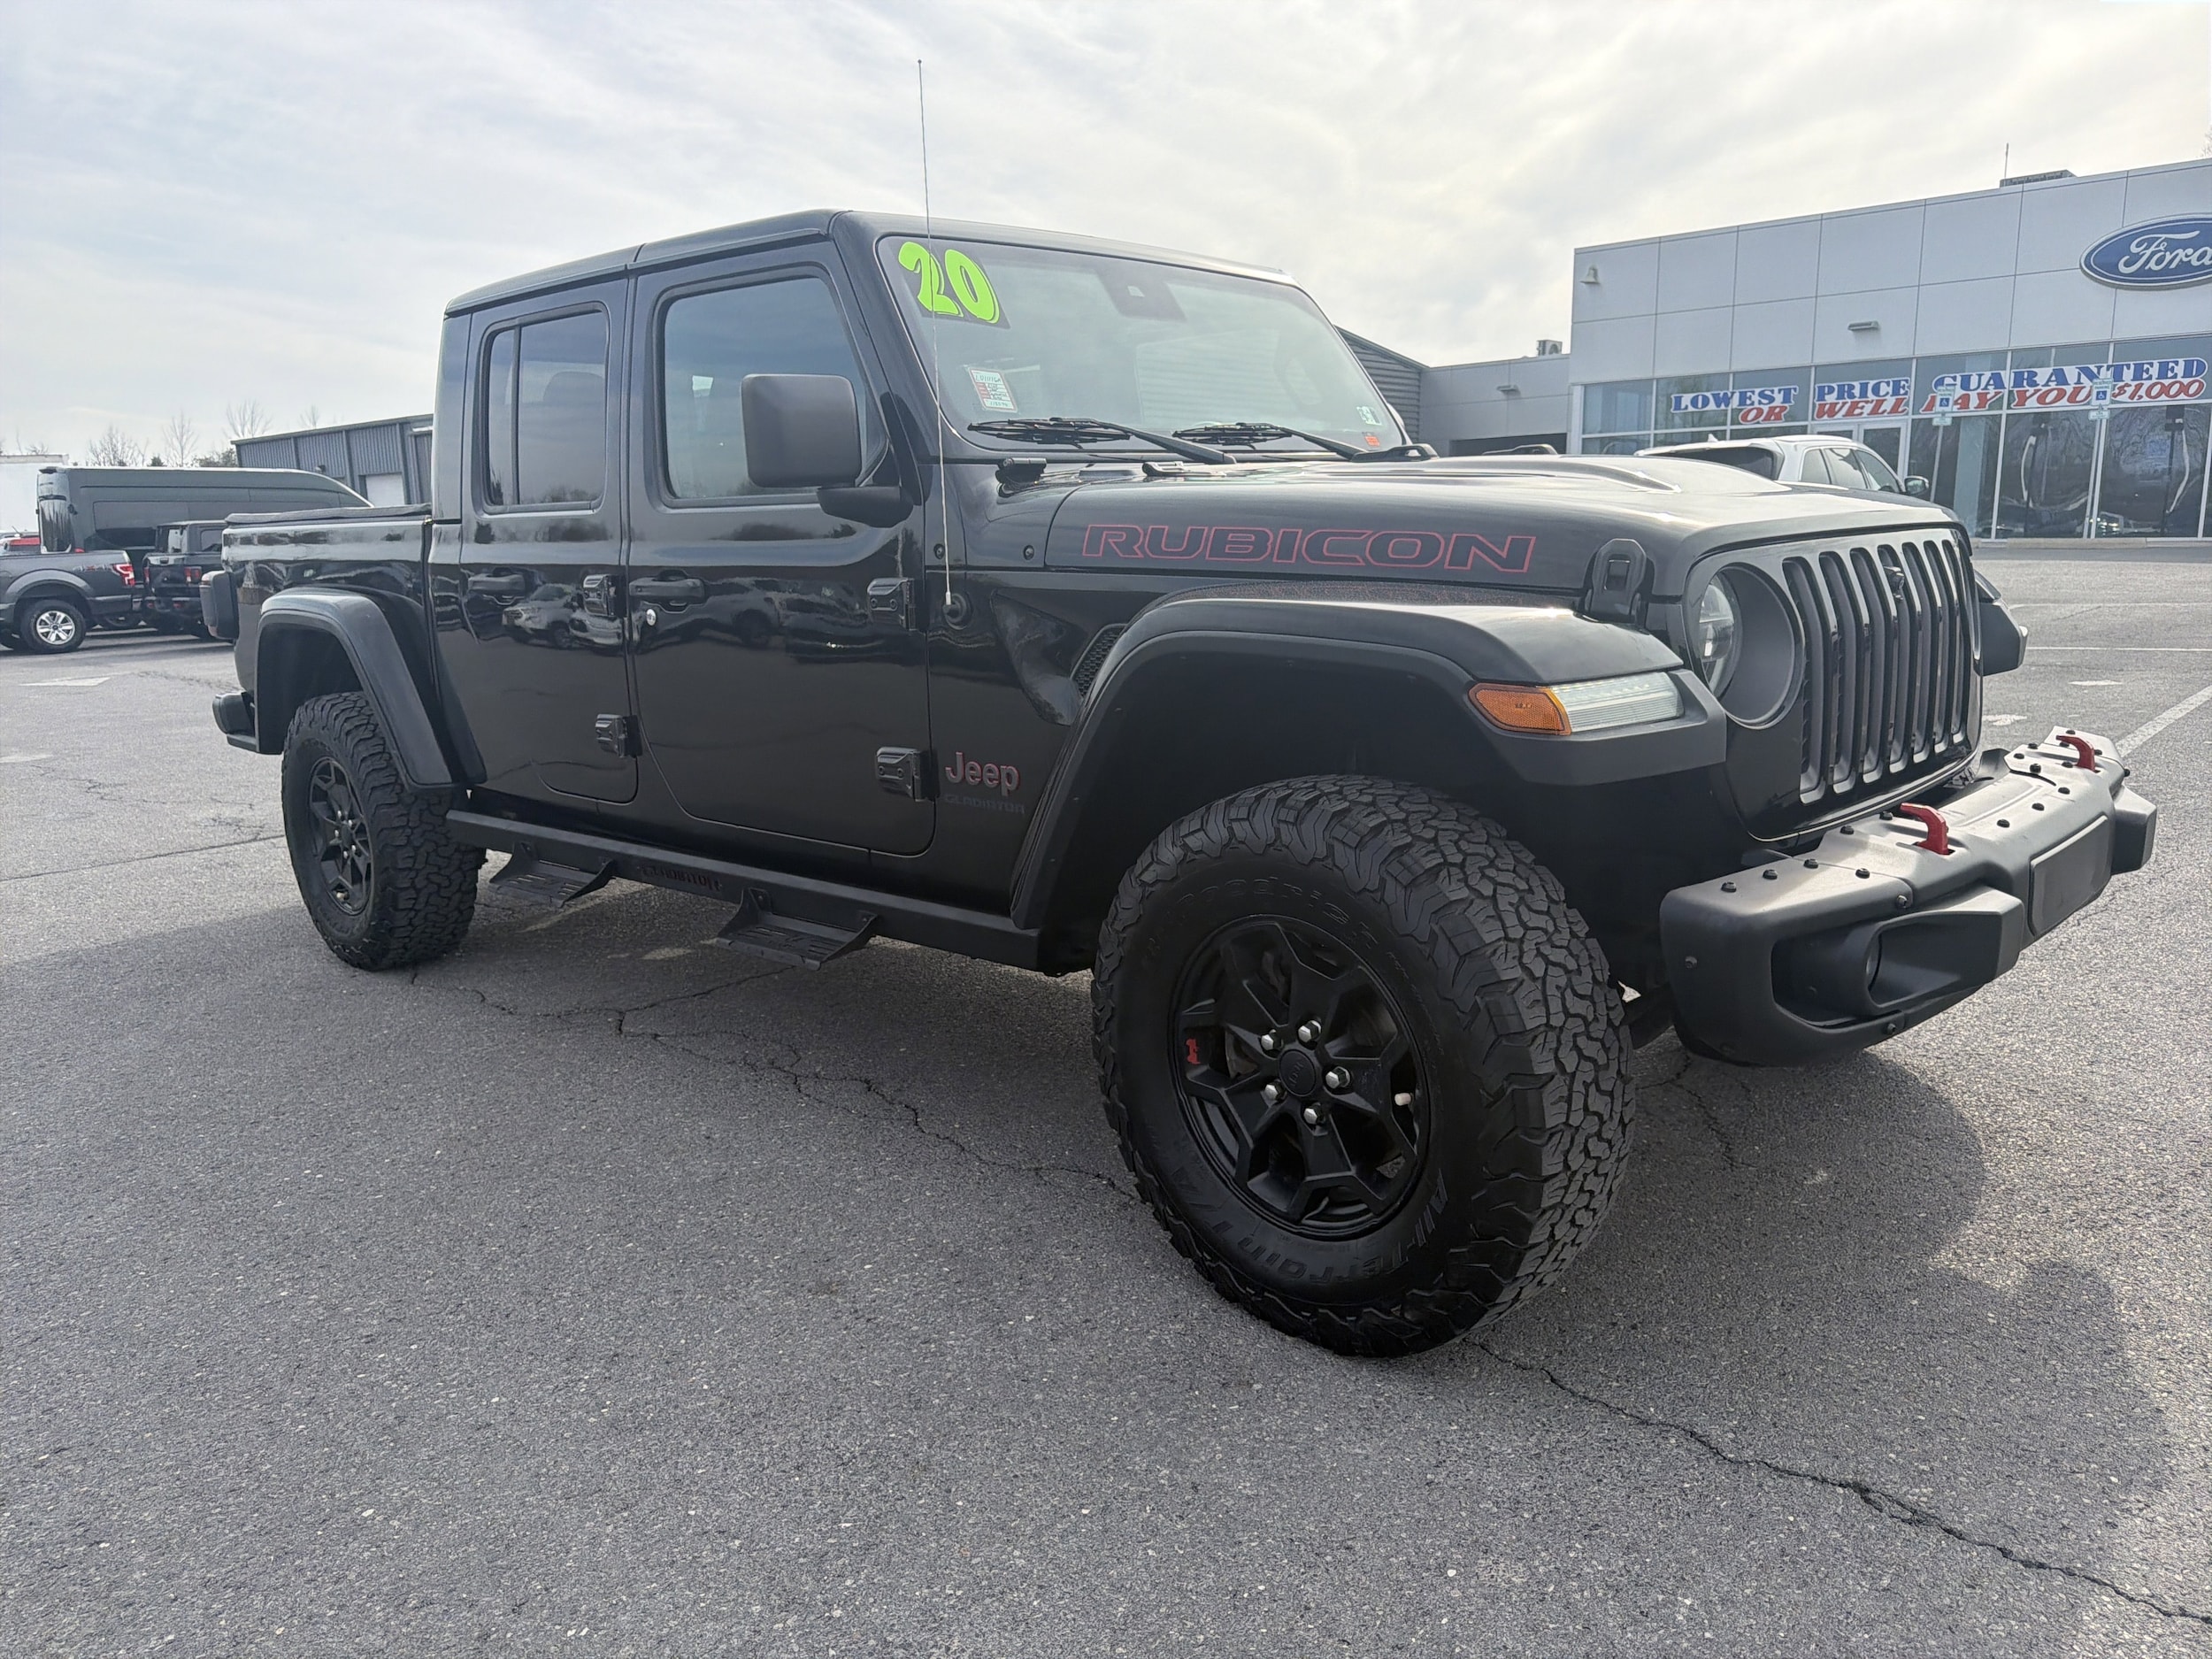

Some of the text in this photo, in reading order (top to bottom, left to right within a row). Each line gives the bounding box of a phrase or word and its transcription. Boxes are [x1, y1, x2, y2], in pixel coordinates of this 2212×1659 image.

[898, 241, 1000, 324] 20
[1672, 358, 2207, 411] LOWEST PRICE GUARANTEED
[1740, 405, 1788, 424] OR
[2012, 385, 2094, 407] YOU
[2111, 379, 2206, 401] $1,000
[1081, 524, 1537, 573] RUBICON
[944, 751, 1020, 797] Jeep
